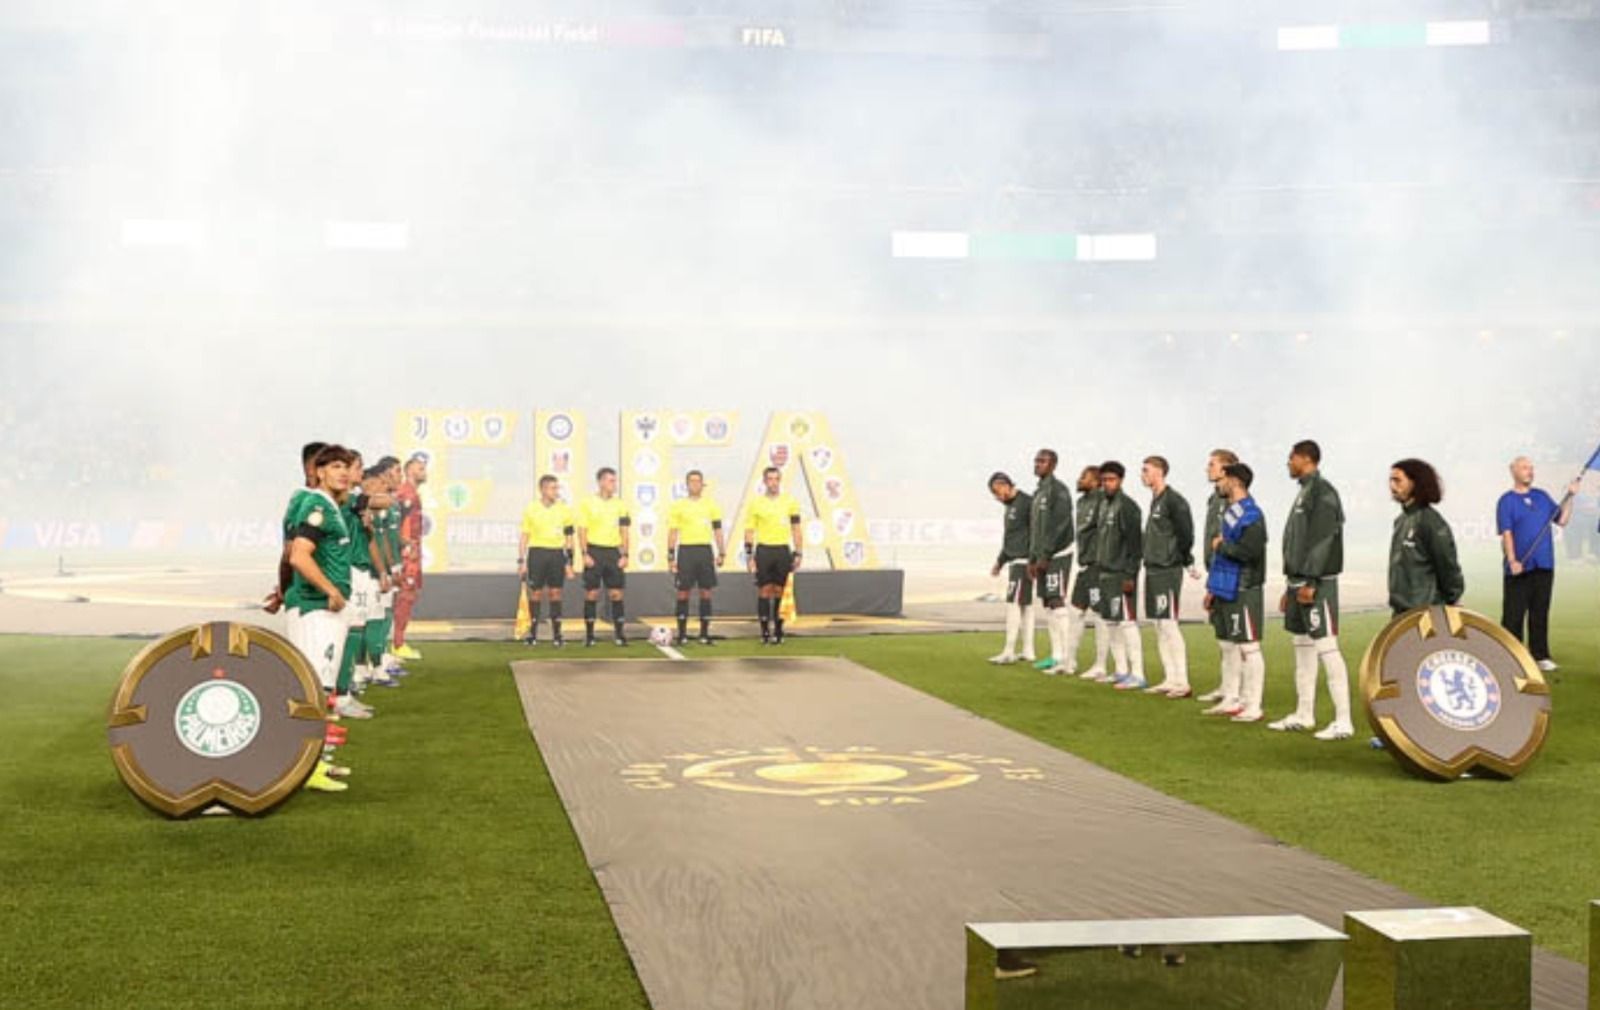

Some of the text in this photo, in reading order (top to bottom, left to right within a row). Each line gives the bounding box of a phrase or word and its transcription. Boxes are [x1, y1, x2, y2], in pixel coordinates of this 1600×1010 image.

[743, 28, 785, 47] FIFA
[34, 521, 102, 549] VISA
[324, 642, 335, 662] 4
